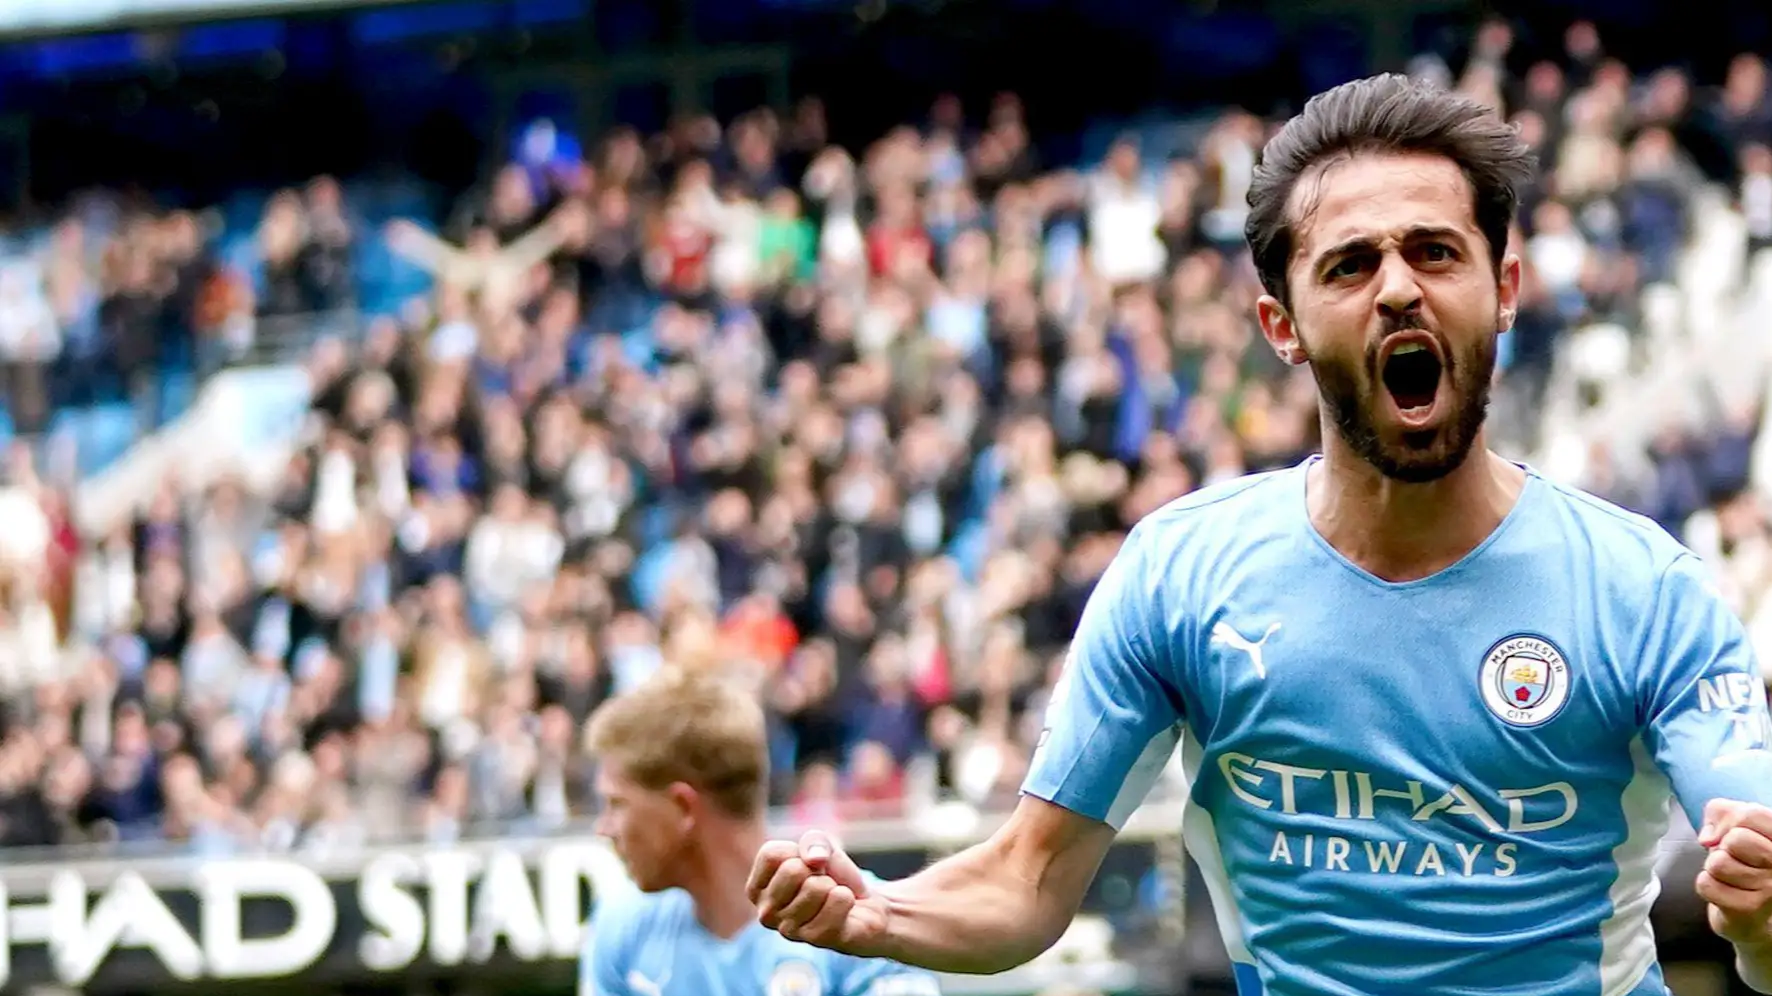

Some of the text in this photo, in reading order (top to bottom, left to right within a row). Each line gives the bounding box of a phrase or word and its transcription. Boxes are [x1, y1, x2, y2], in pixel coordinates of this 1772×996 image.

[1491, 641, 1563, 672] MANCHESTER
[1507, 710, 1534, 720] CITY
[1216, 751, 1579, 834] ETIHAD
[1269, 830, 1518, 878] AIRWAYS
